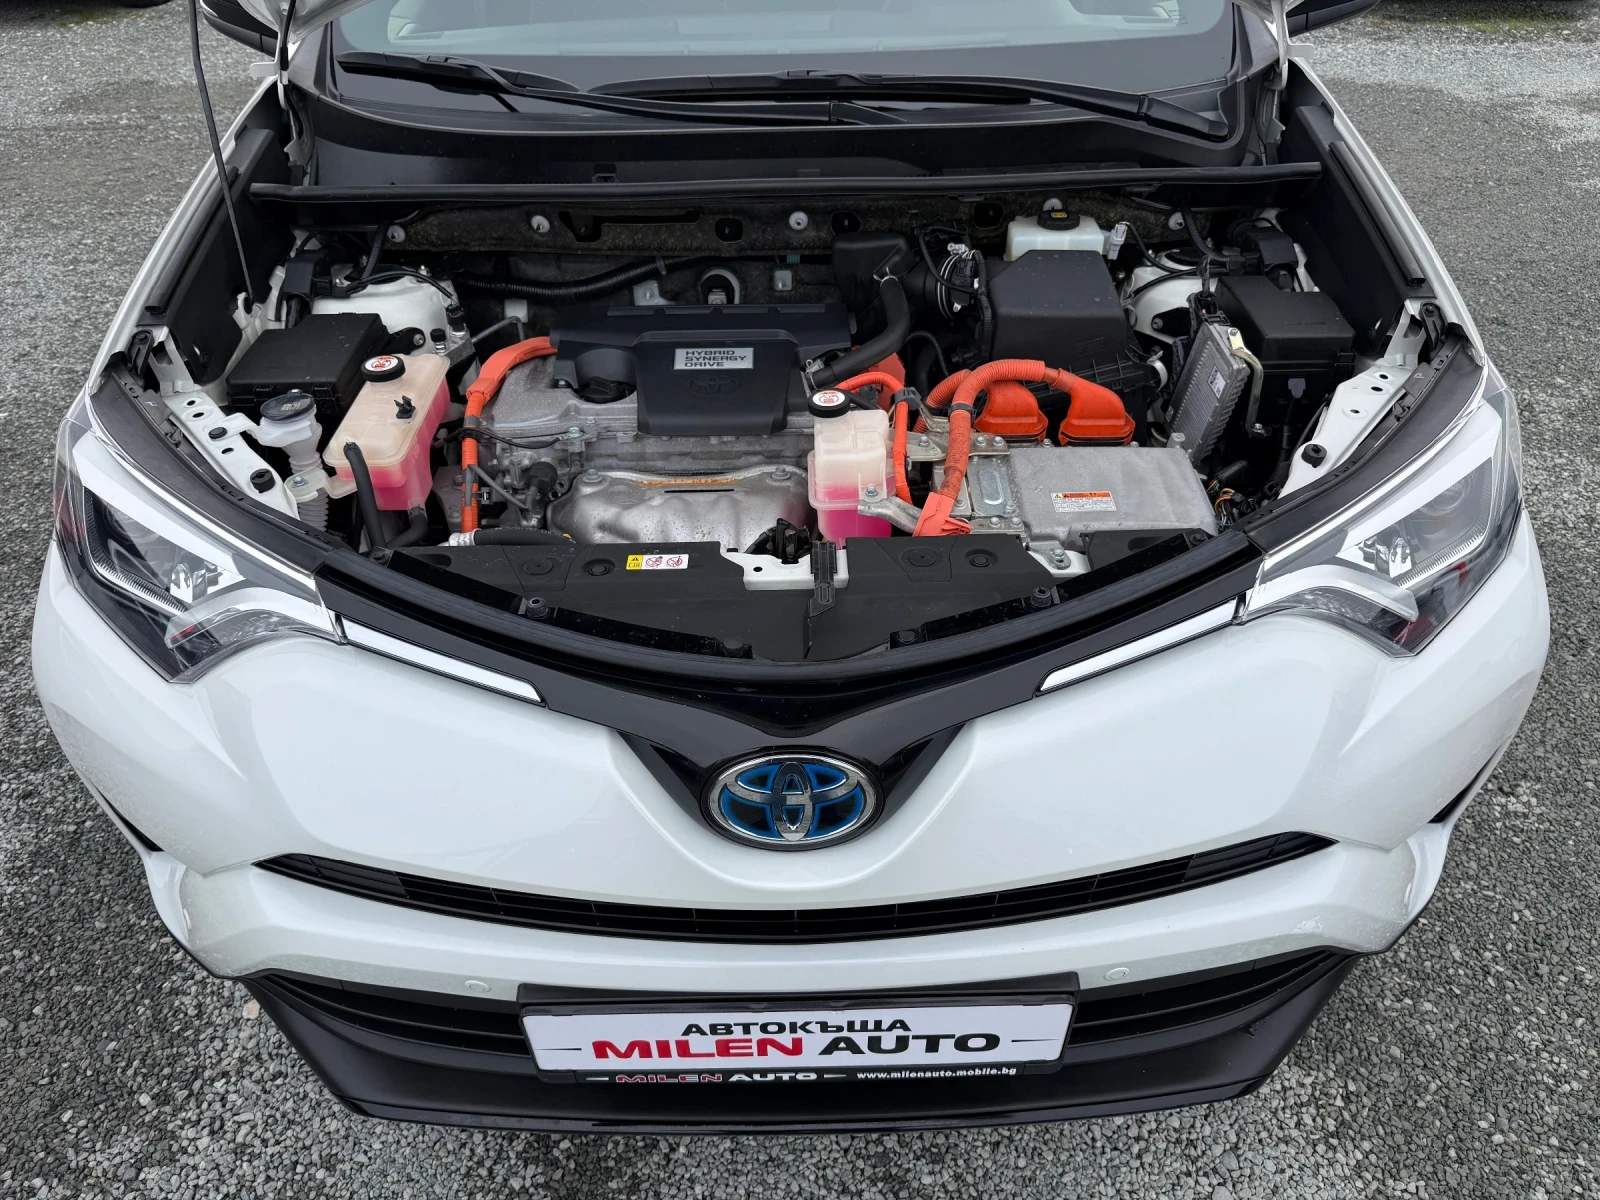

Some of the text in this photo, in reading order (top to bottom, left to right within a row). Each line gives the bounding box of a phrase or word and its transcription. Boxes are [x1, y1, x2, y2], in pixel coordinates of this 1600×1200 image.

[592, 1033, 1001, 1059] MILEN AUTO
[615, 1067, 1017, 1083] MILEN AUTO www.milenauto.mobile.bg
